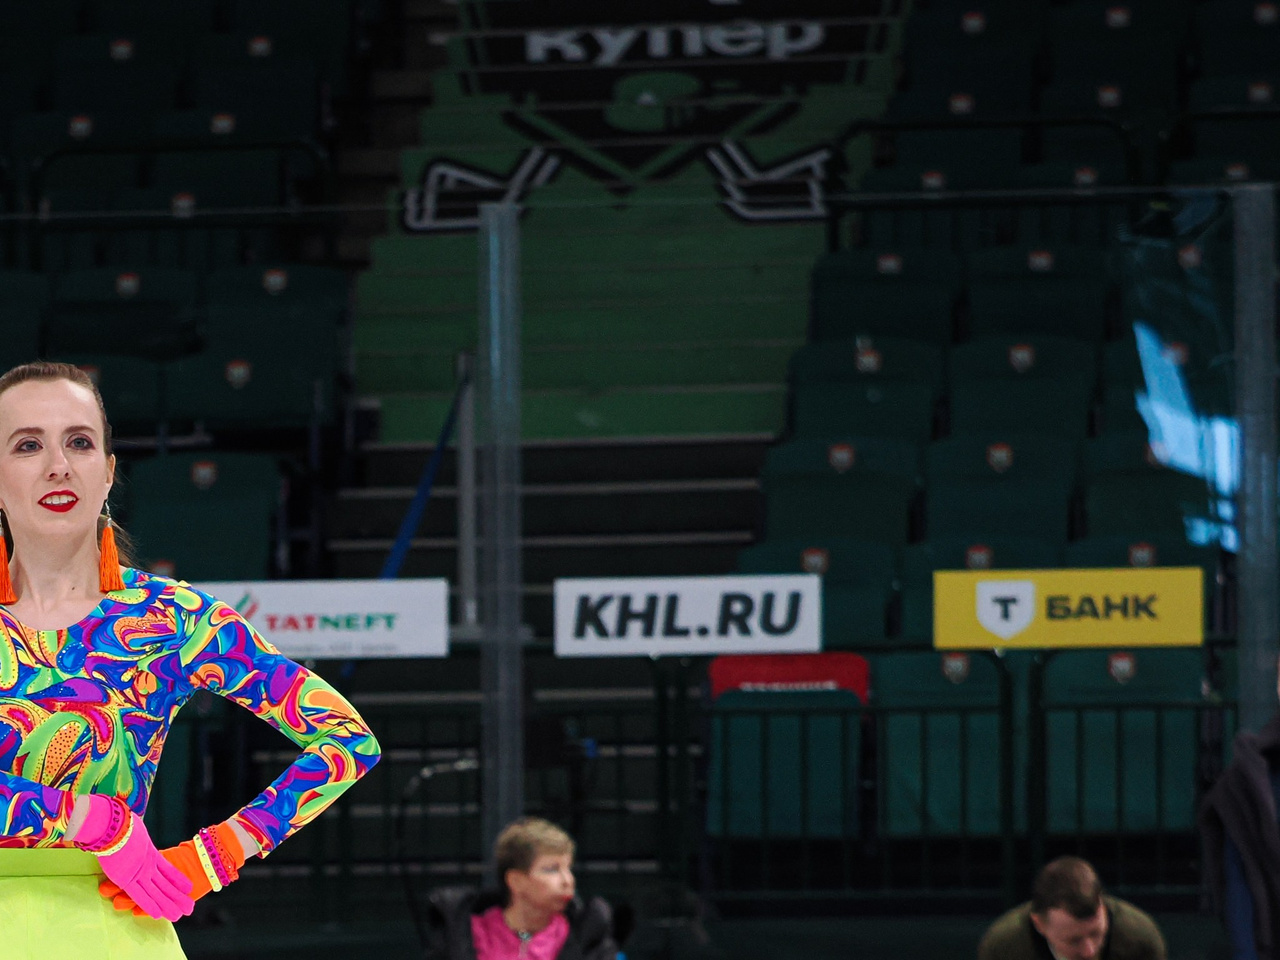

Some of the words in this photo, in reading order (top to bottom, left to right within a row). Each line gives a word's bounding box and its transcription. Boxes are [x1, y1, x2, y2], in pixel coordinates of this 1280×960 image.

[574, 591, 803, 639] KHL.RU
[1045, 594, 1158, 621] БАНК
[265, 613, 398, 631] TATNEFT
